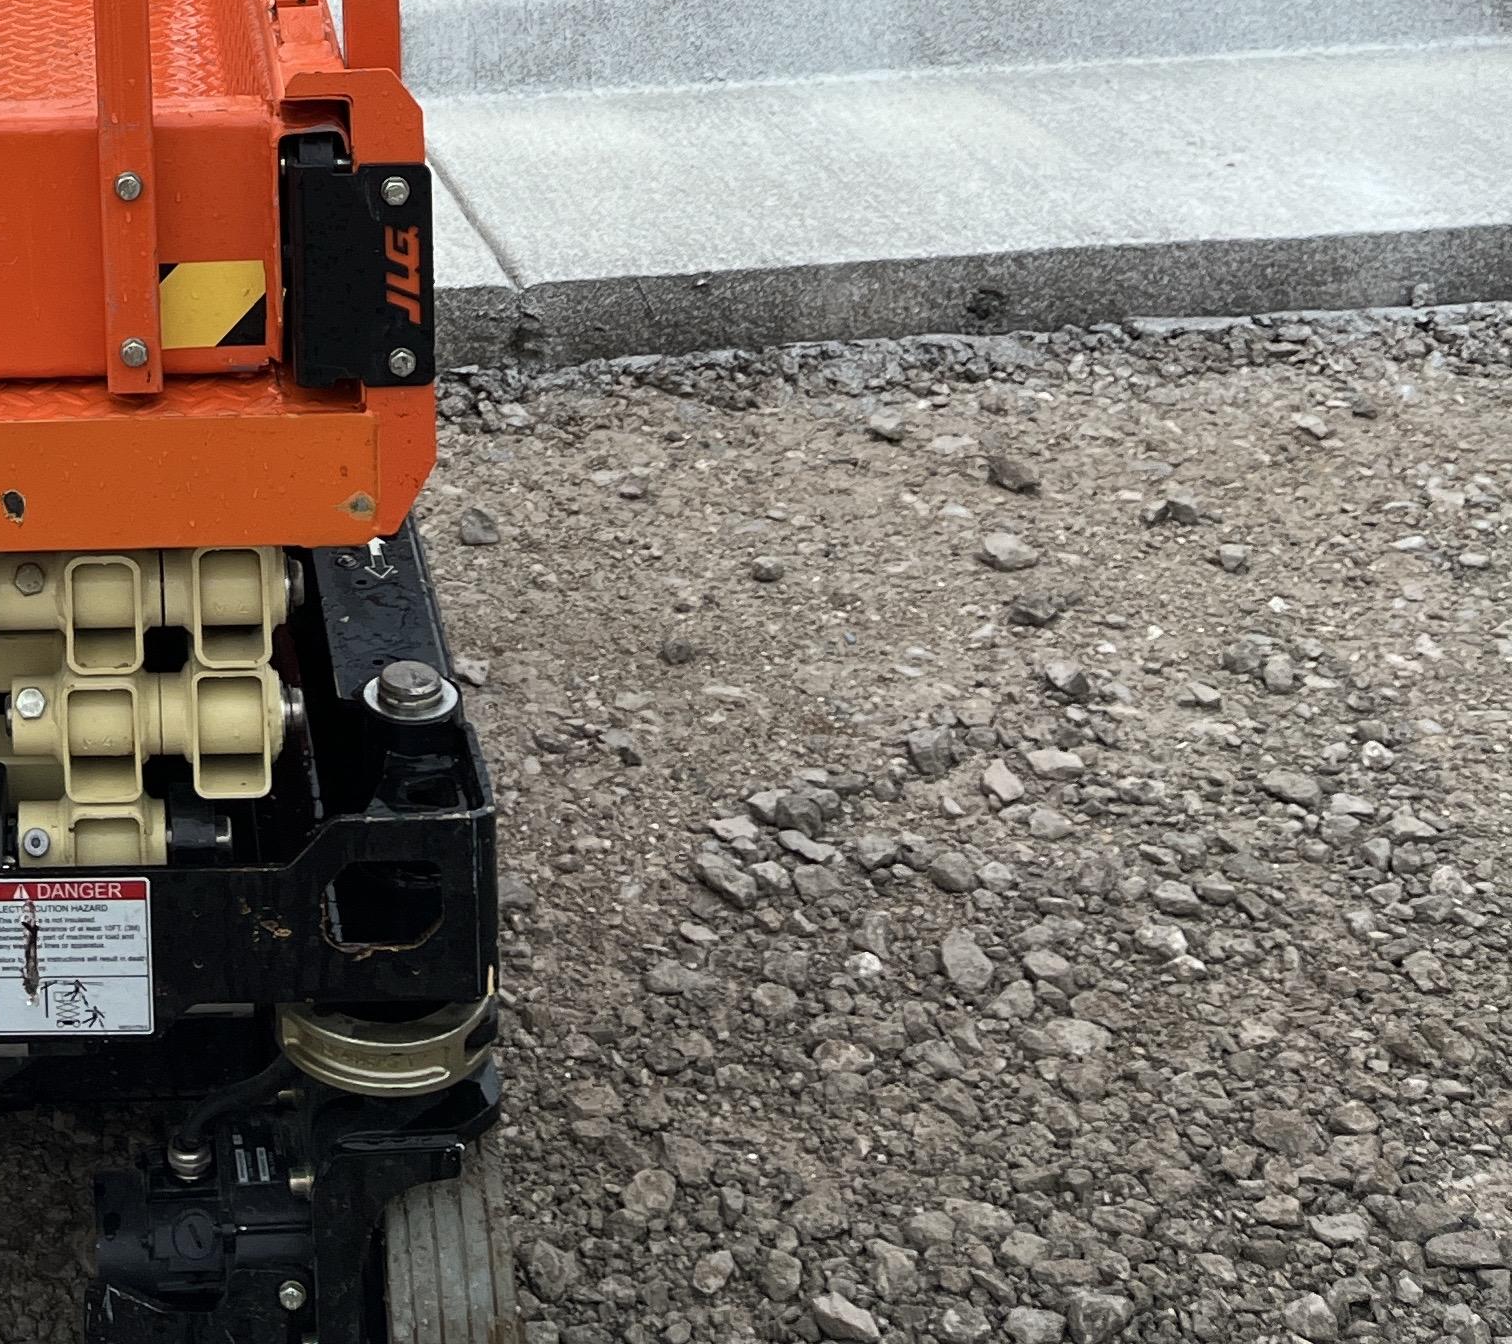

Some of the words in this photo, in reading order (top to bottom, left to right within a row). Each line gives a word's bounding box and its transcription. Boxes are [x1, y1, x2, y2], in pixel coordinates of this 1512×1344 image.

[384, 226, 422, 325] JLG
[38, 882, 122, 899] DANGER
[70, 904, 108, 913] HAZARD
